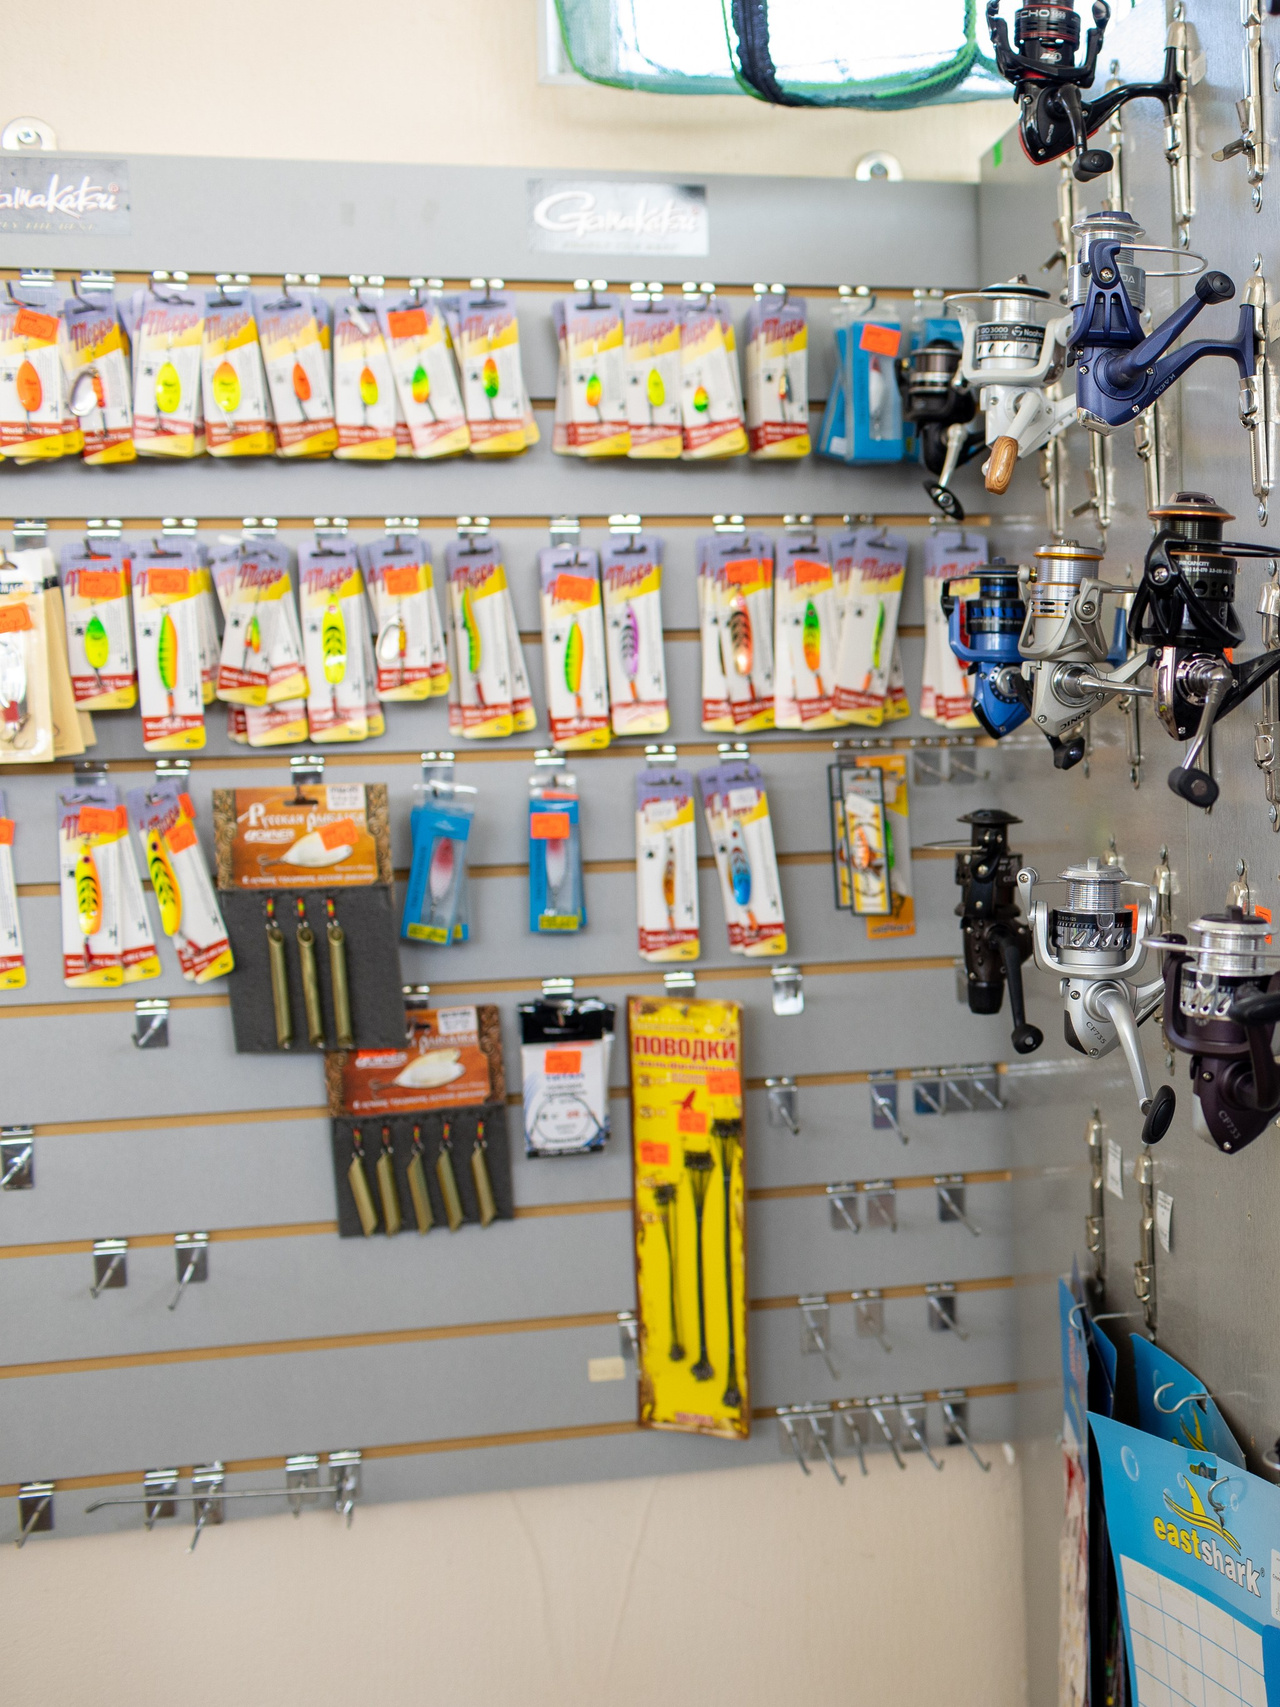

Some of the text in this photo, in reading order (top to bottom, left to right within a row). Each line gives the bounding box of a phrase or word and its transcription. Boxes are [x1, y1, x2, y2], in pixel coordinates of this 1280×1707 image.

[0, 173, 119, 219] amakatsu
[1060, 708, 1092, 731] SONIC
[1086, 1021, 1107, 1044] CF735
[635, 1036, 736, 1061] ПОВОДКИ
[1153, 1516, 1261, 1598] eastshark
